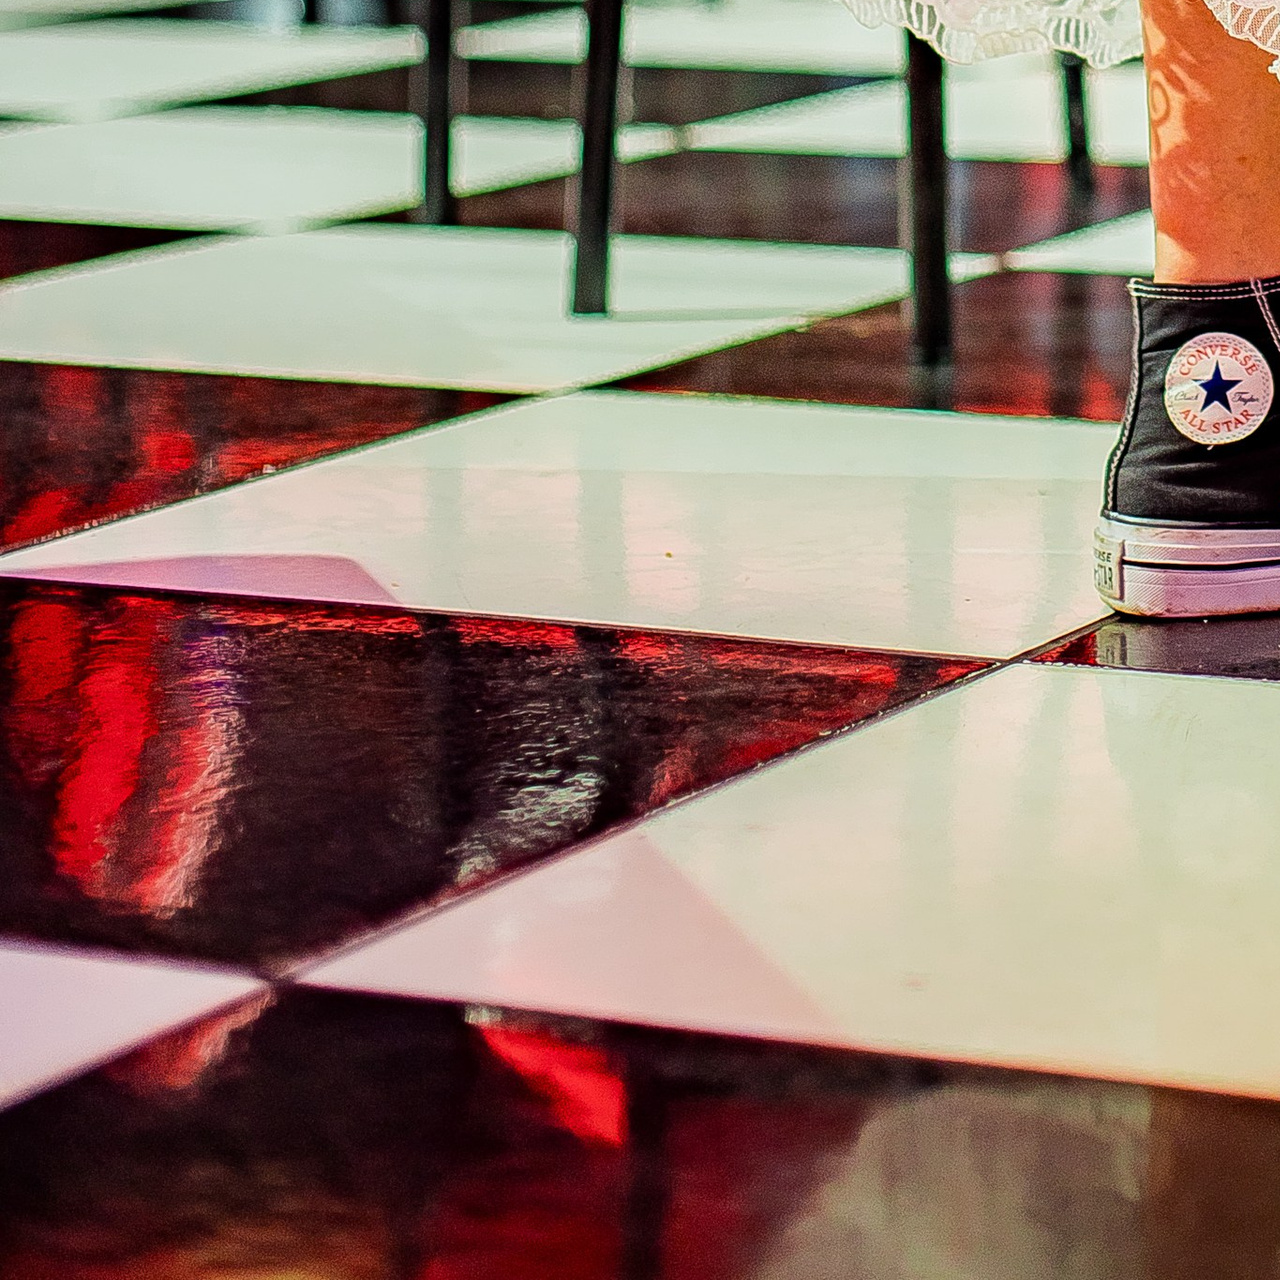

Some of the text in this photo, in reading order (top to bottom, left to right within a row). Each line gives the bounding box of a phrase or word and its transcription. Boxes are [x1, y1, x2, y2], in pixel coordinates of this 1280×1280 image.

[1179, 344, 1259, 376] CONVERSE
[1180, 408, 1254, 434] ALL STAR
